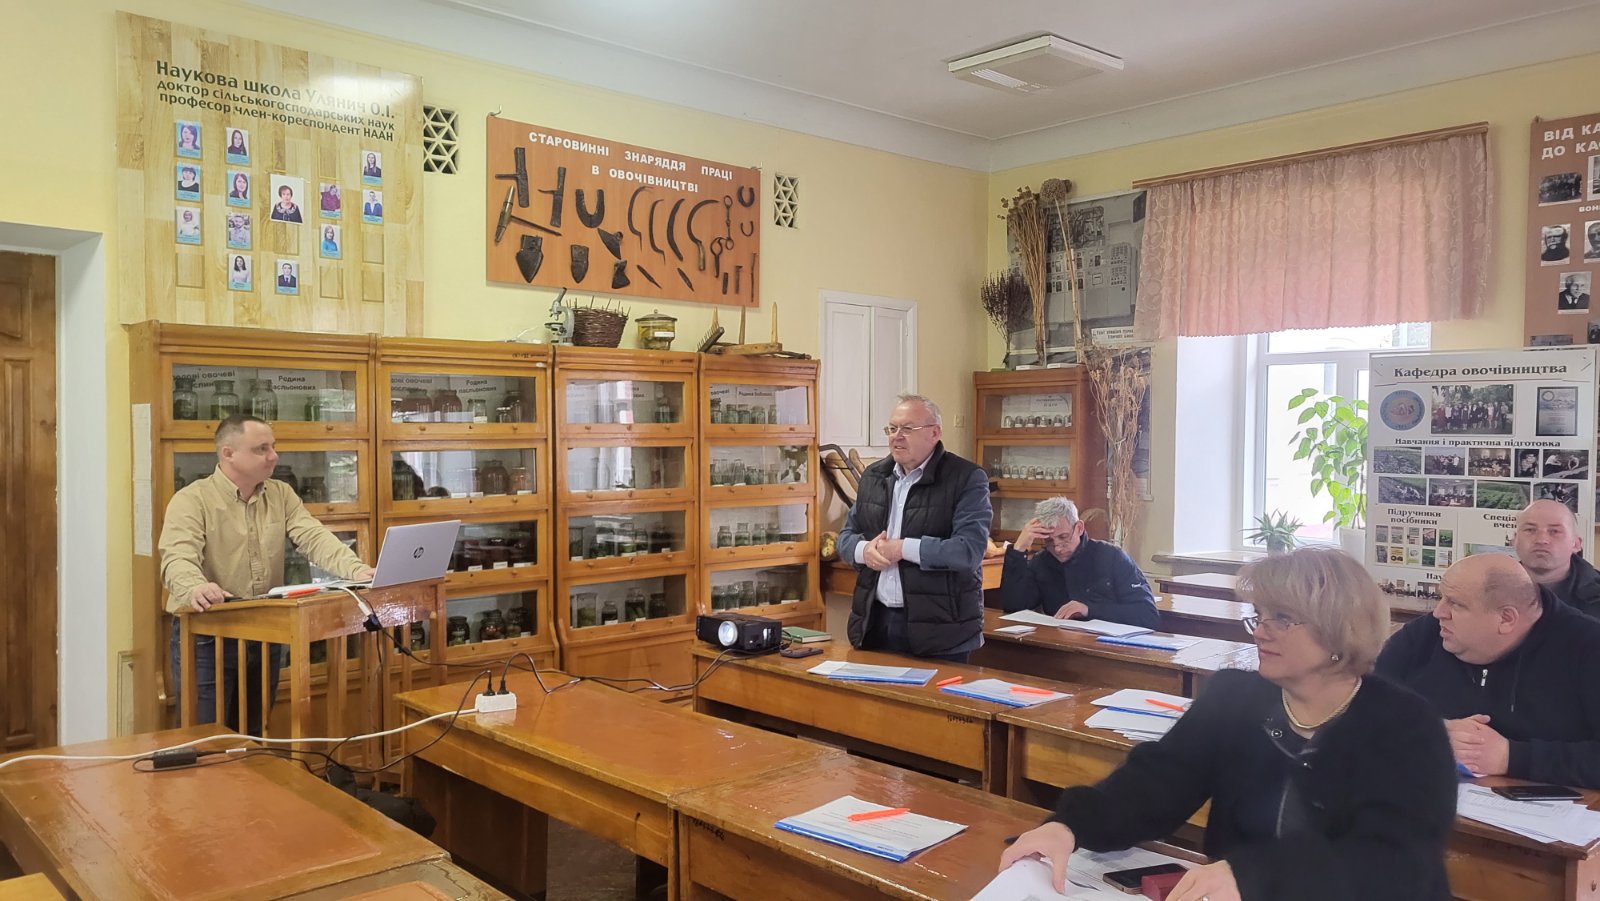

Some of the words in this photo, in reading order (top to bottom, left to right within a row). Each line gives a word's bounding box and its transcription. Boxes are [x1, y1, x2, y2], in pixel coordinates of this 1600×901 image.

[156, 60, 238, 88] Наукова
[243, 79, 300, 100] школа
[370, 102, 395, 119] О.І.
[157, 80, 209, 98] доктор
[212, 88, 365, 125] сільськогосподарських
[367, 118, 395, 131] наук
[363, 127, 394, 142] НААН
[1544, 127, 1574, 142] ВІД
[1582, 123, 1600, 135] КА
[528, 132, 609, 156] СТАРОВИННІ
[624, 150, 687, 172] ЗНАРЯДДЯ
[701, 165, 734, 181] ПРАЦІ
[1541, 146, 1566, 160] ДО
[1575, 140, 1600, 154] КА
[608, 167, 699, 194] ОВОЧІВНИЦТВІ
[278, 375, 306, 383] Родина
[1394, 367, 1457, 379] Кафедра
[1461, 364, 1567, 376] овочівництва
[1395, 438, 1440, 446] Навчання
[1448, 438, 1501, 447] практична
[1504, 438, 1561, 448] підготовка
[1387, 508, 1442, 519] Підручники
[1483, 513, 1517, 522] Спеціа
[1390, 517, 1438, 526] посібники
[1426, 572, 1442, 580] Нау
